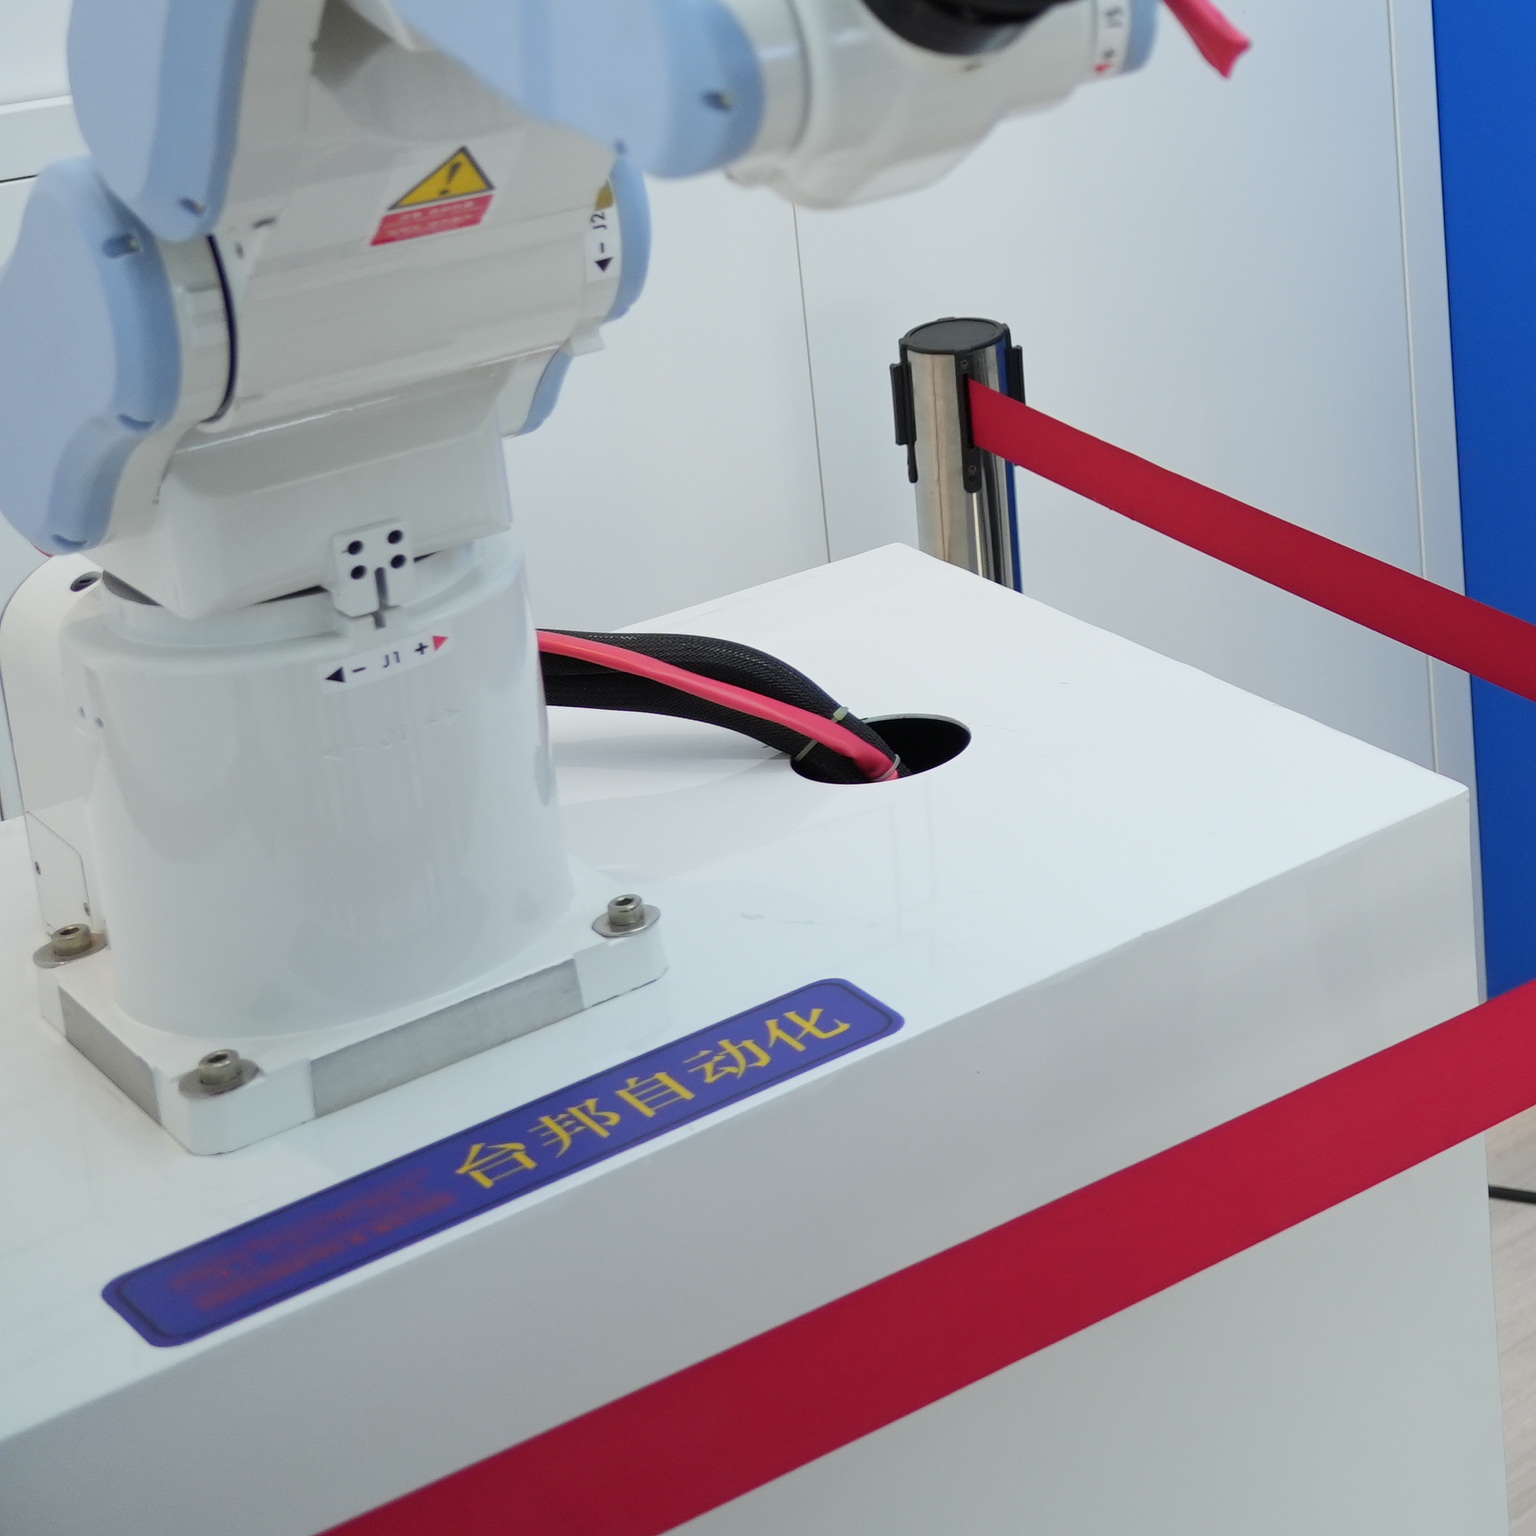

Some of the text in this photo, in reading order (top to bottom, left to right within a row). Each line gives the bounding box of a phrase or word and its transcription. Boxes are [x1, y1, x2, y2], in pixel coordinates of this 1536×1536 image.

[382, 650, 401, 669] J1
[456, 1007, 851, 1188] 台邦自动化
